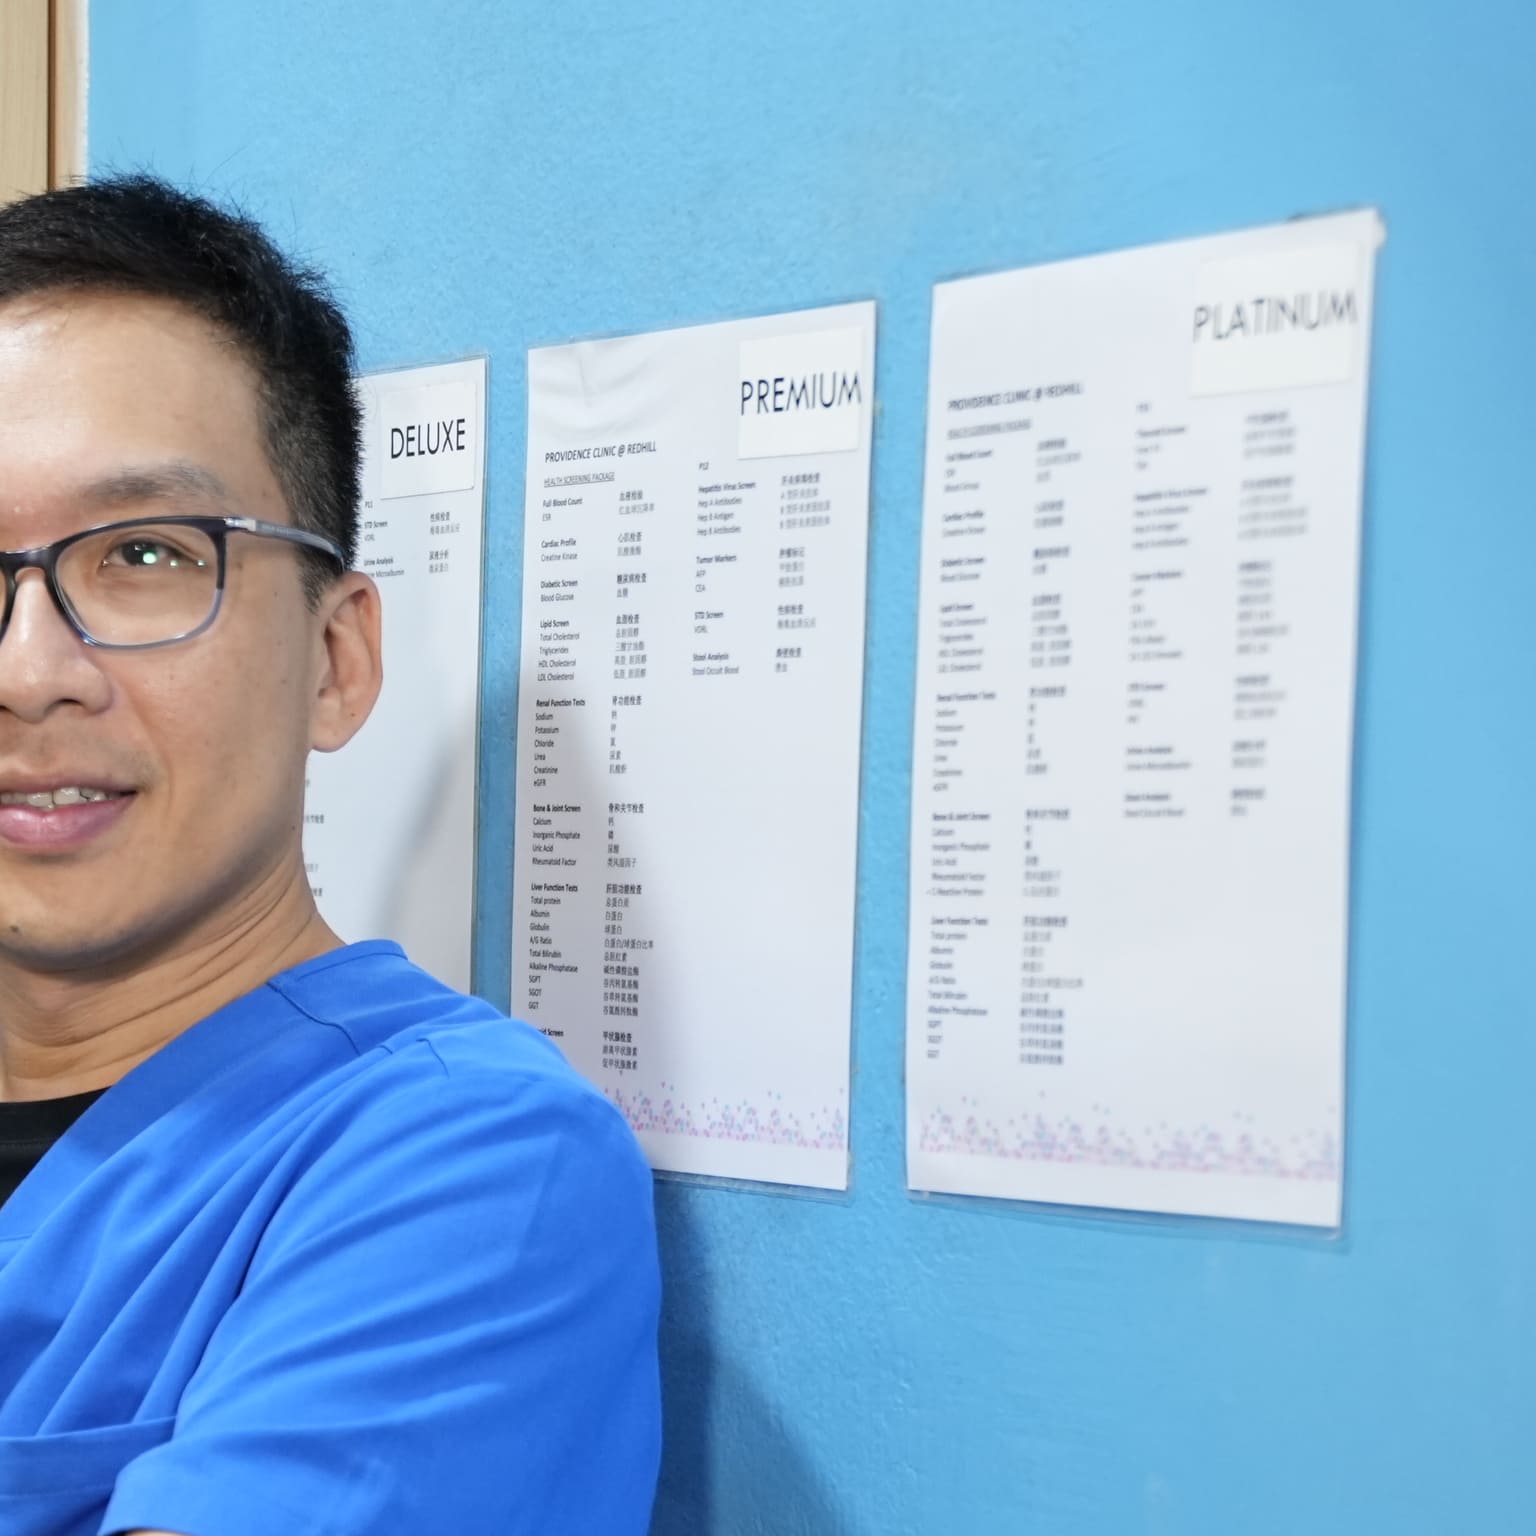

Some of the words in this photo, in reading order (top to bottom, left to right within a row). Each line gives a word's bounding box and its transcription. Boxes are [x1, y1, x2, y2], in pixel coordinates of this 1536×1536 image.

[1193, 290, 1357, 344] PLATINUM
[741, 371, 862, 416] PREMIUM
[391, 419, 465, 459] DELUXE
[545, 448, 591, 463] PROVIDENCE
[593, 446, 616, 458] CLINIC
[618, 444, 625, 457] @
[627, 441, 656, 454] REDHILL
[553, 499, 567, 507] Blood
[568, 498, 582, 506] Count
[541, 540, 559, 548] Cardiac
[560, 538, 576, 546] Profile
[540, 580, 560, 588] Diabetic
[562, 579, 578, 587] Screen
[540, 620, 552, 628] Lipid
[540, 633, 552, 641] Total
[553, 632, 580, 640] Cholesterol
[549, 659, 576, 667] Cholesterol
[536, 699, 549, 707] Renal
[535, 713, 553, 721] Sodium
[534, 766, 558, 774] Creatinine
[533, 831, 554, 840] Inorganic
[532, 858, 560, 866] Rheumatoid
[562, 858, 576, 866] Factor
[531, 883, 542, 891] Liver
[544, 884, 564, 892] Function
[566, 884, 578, 892] Tests
[531, 896, 542, 904] Total
[549, 964, 578, 973] Phosphatase
[529, 1001, 538, 1009] GGT
